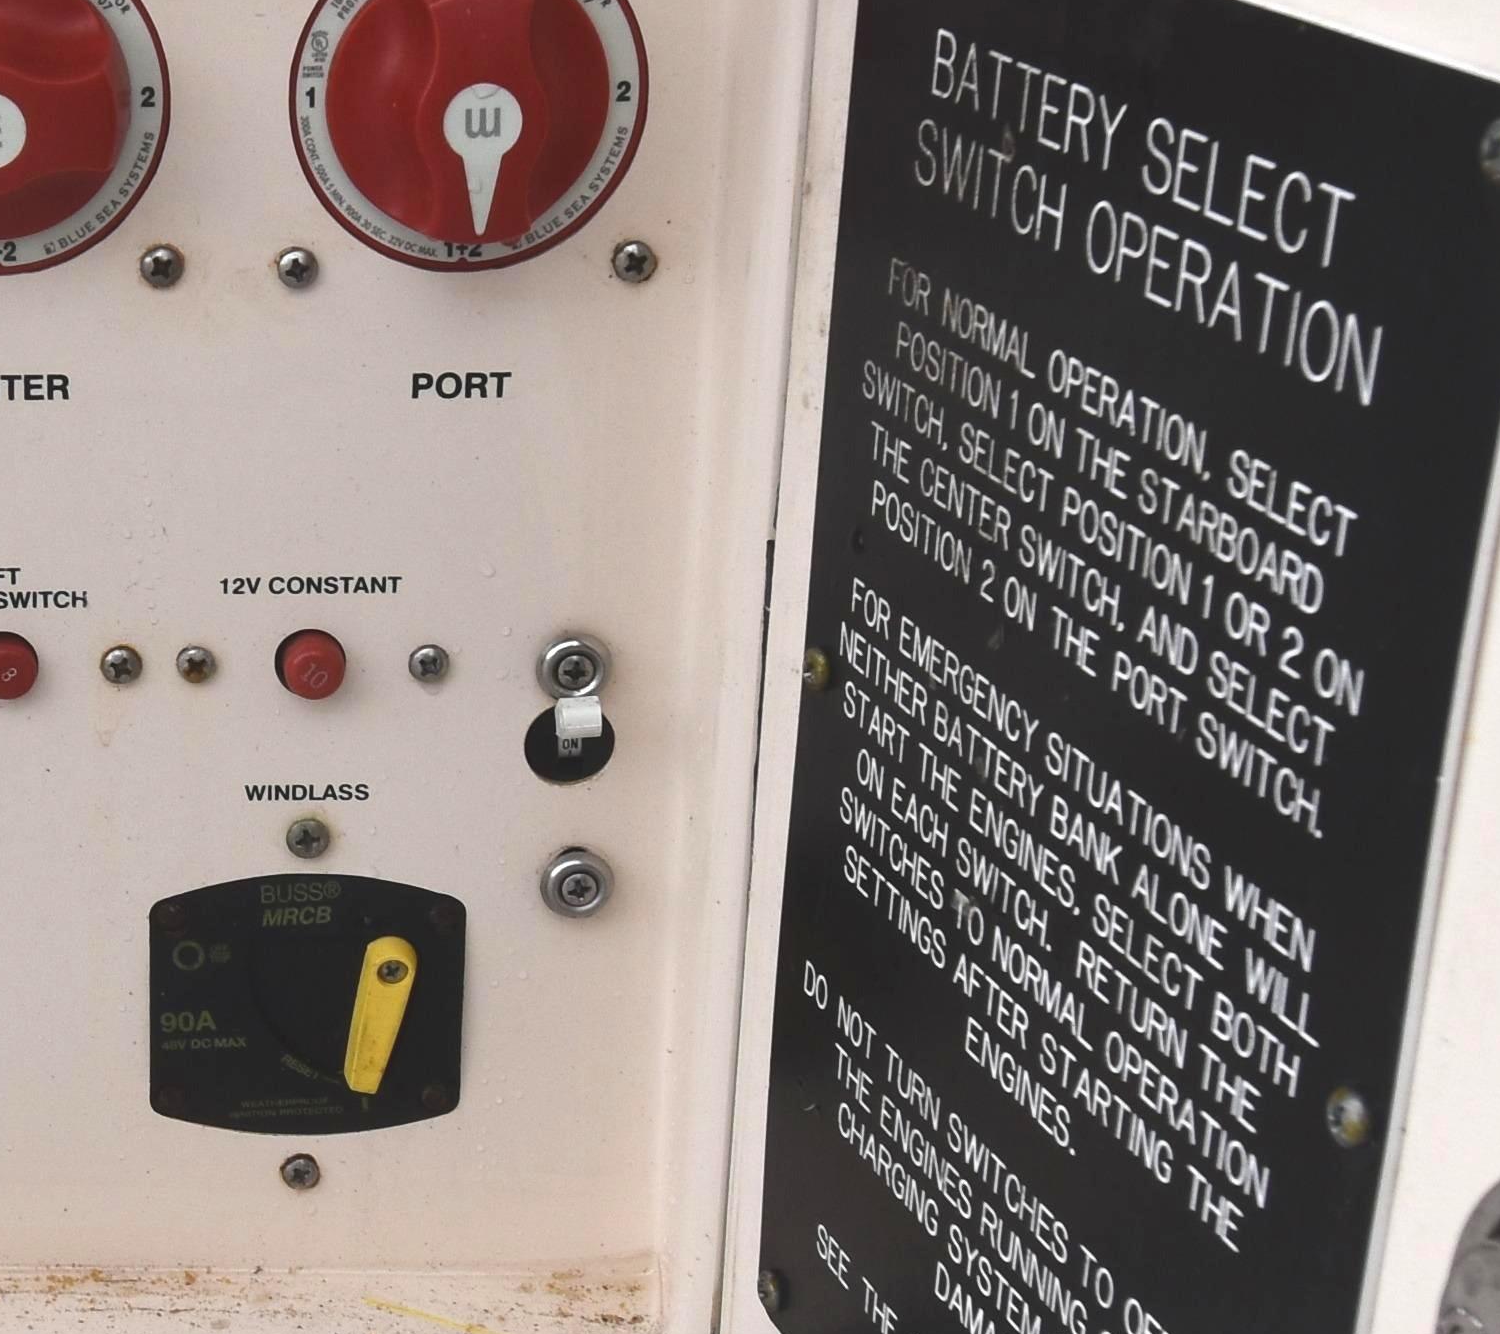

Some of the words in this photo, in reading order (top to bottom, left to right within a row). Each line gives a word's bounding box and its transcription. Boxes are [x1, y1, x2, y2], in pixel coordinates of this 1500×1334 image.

[140, 87, 156, 108] 2
[305, 87, 316, 108] 1
[616, 81, 632, 102] 2
[932, 28, 1128, 170] BATTERY
[1143, 117, 1356, 268] SELECT
[59, 220, 95, 249] BLUE
[95, 196, 120, 224] SEA
[118, 131, 155, 197] SYSTEMS
[444, 242, 483, 258] 1+2
[525, 217, 564, 247] BLUE
[565, 193, 590, 219] SEA
[588, 126, 628, 193] SYSTEMS
[915, 119, 1067, 252] SWITCH
[1087, 200, 1383, 406] OPERATION
[411, 371, 512, 401] PORT
[889, 258, 931, 316] FOR
[943, 288, 1036, 379] NORMAL
[1048, 349, 1210, 481] OPERATION,
[1228, 449, 1358, 557] SELECT
[896, 322, 1000, 419] POSITION
[1009, 390, 1019, 430] 1
[1027, 403, 1065, 458] ON
[1076, 428, 1131, 499] THE
[1138, 468, 1324, 614] STARBOARD
[219, 577, 261, 595] 12V
[268, 576, 402, 595] CONSTANT
[862, 361, 948, 451] SWITCH,
[959, 422, 1054, 512] SELECT
[1061, 487, 1192, 605] POSITION
[1203, 575, 1214, 619] 1
[1224, 592, 1271, 657] OR
[1279, 626, 1303, 680] 2
[1313, 648, 1364, 716] ON
[871, 422, 910, 484] THE
[920, 457, 1011, 551] CENTER
[1019, 524, 1125, 632] SWITCH,
[1137, 606, 1199, 676] AND
[1207, 650, 1335, 767] SELECT
[872, 480, 972, 584] POSITION
[980, 559, 995, 602] 2
[1004, 576, 1037, 631] ON
[1051, 606, 1100, 677] THE
[1111, 651, 1188, 733] PORT
[1196, 712, 1323, 838] SWITCH.
[244, 784, 369, 802] WINDLASS
[562, 738, 578, 749] ON
[851, 577, 891, 640] FOR
[900, 616, 1039, 752] EMERGENCY
[1045, 732, 1211, 890] SITUATIONS
[1224, 865, 1315, 972] WHEN
[839, 621, 928, 726] NEITHER
[933, 700, 1044, 817] BATTERY
[1050, 794, 1123, 885] BANK
[1131, 864, 1228, 970] ALONE
[1245, 947, 1320, 1048] WILL
[843, 681, 911, 763] START
[918, 742, 962, 812] THE
[968, 787, 1080, 916] ENGINES,
[1092, 893, 1204, 1010] SELECT
[1211, 991, 1301, 1098] BOTH
[262, 906, 332, 927] MRCB
[857, 749, 884, 800] ON
[891, 777, 948, 858] EACH
[956, 837, 1052, 952] SWITCH.
[1076, 940, 1188, 1069] RETURN
[1200, 1043, 1262, 1133] THE
[160, 1010, 216, 1032] 90A
[191, 1038, 212, 1050] DC
[214, 1036, 246, 1049] MAX
[840, 787, 944, 910] SWITCHES
[952, 887, 984, 946] TO
[992, 925, 1094, 1051] NORMAL
[1104, 1031, 1270, 1209] OPERATION
[844, 845, 946, 968] SETTINGS
[953, 953, 1029, 1050] AFTER
[1039, 1033, 1174, 1184] STARTING
[1187, 1164, 1244, 1253] THE
[804, 960, 828, 1010] DO
[837, 996, 877, 1058] NOT
[885, 1043, 941, 1131] TURN
[948, 1112, 1069, 1264] SWITCHES
[1079, 1244, 1113, 1309] TO
[835, 1042, 874, 1114] THE
[880, 1095, 973, 1220] ENGINES
[965, 1017, 1076, 1156] ENGINES.
[838, 1102, 938, 1236] CHARGING
[816, 1224, 851, 1290] SEE
